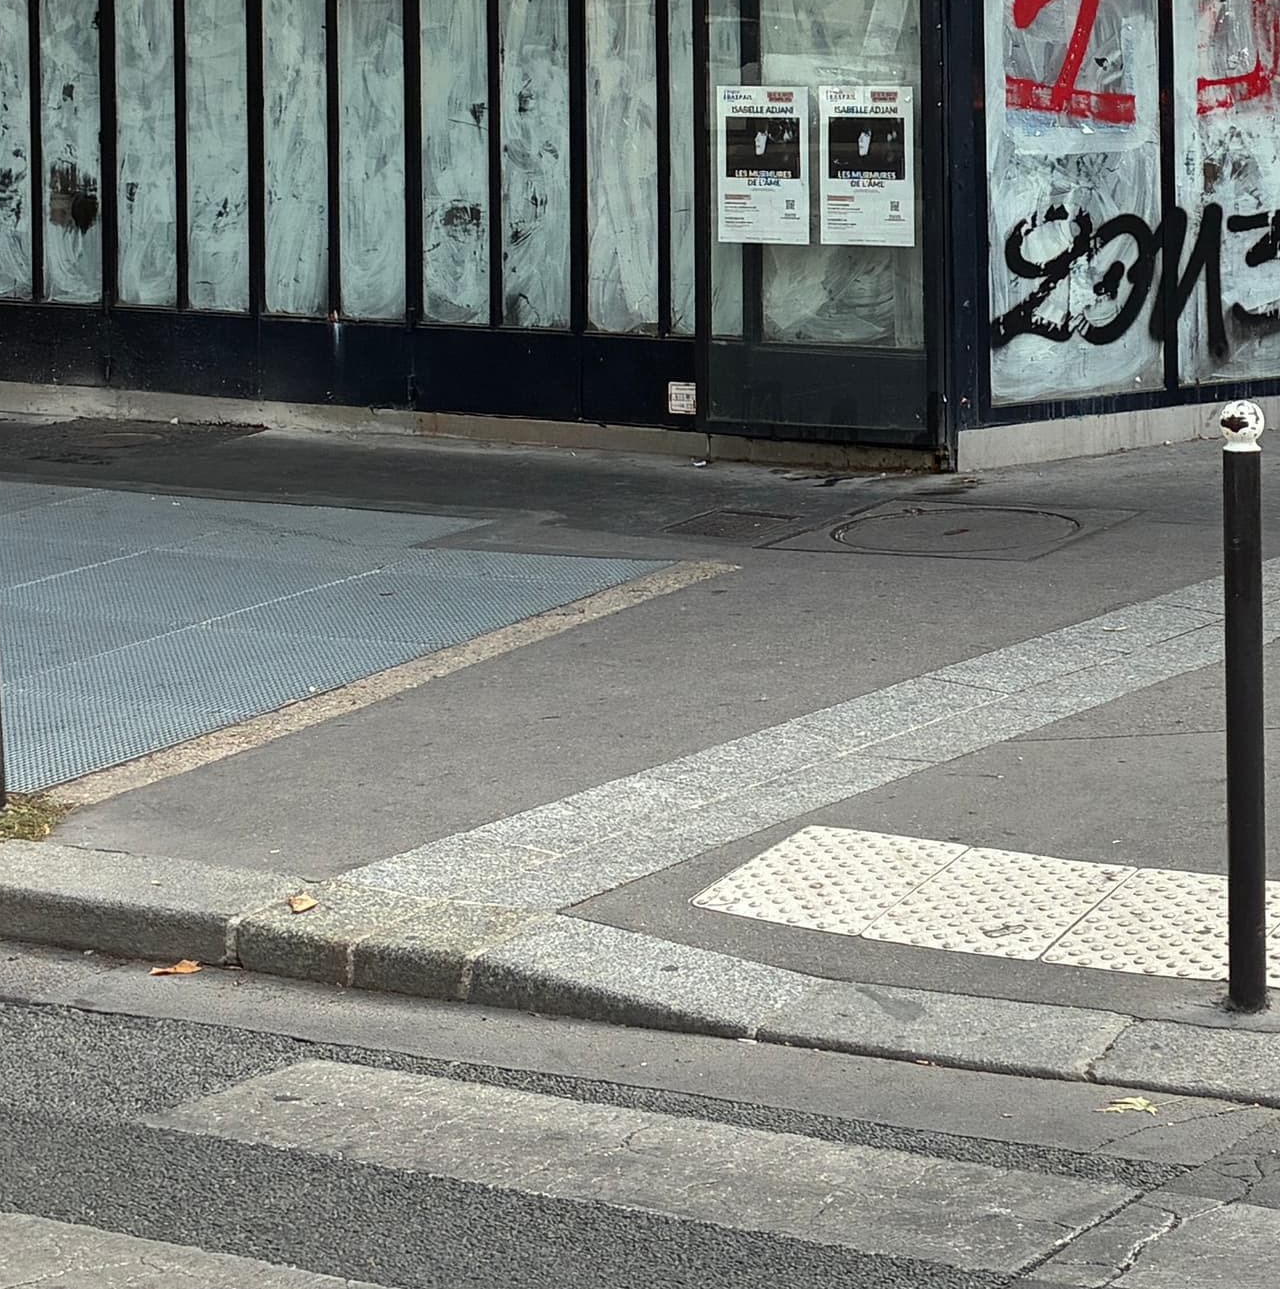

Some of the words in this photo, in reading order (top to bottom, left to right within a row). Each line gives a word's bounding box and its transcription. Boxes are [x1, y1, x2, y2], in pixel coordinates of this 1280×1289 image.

[731, 105, 764, 114] ISABELLE
[765, 106, 794, 114] ADJANI
[834, 105, 868, 114] ISABELLE
[869, 106, 898, 114] ADJANI
[735, 169, 748, 178] LES
[837, 170, 850, 178] LES
